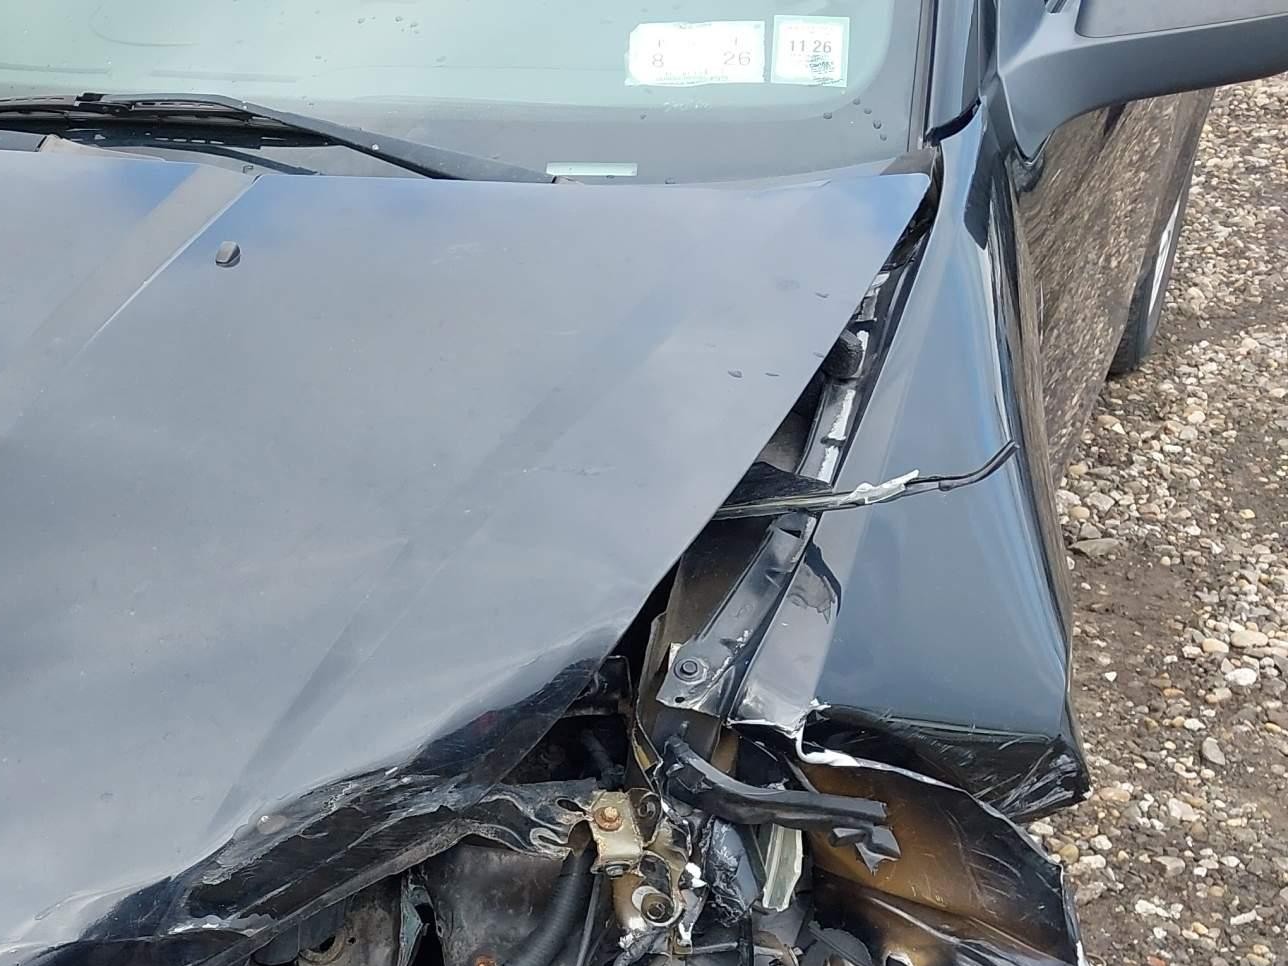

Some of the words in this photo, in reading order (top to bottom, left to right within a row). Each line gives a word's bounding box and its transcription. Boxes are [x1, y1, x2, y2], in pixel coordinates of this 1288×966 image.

[812, 39, 832, 53] 26
[651, 53, 665, 68] 8
[722, 51, 751, 66] 26
